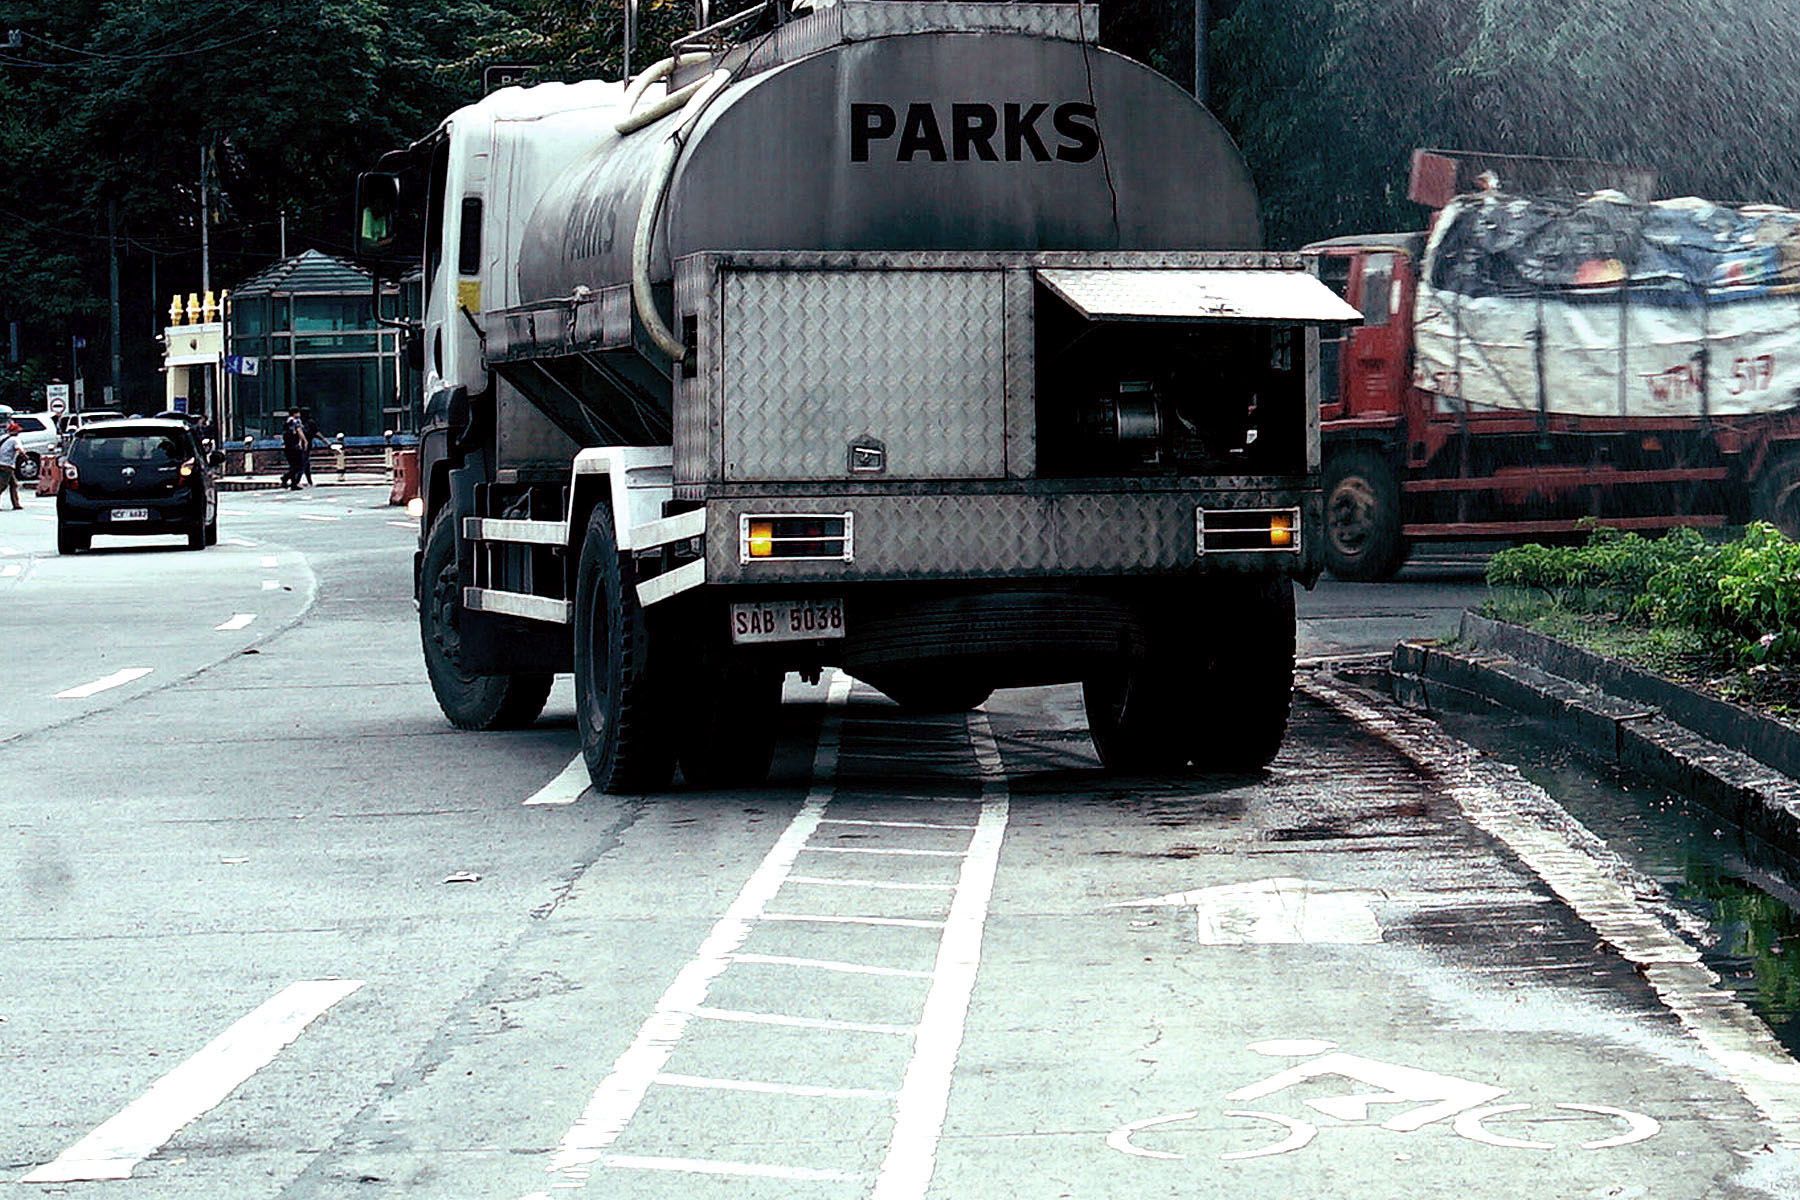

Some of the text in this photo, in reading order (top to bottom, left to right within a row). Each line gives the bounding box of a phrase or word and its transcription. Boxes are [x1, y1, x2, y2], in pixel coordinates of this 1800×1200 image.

[849, 101, 1102, 164] PARKS
[736, 606, 842, 635] SAB 5038
